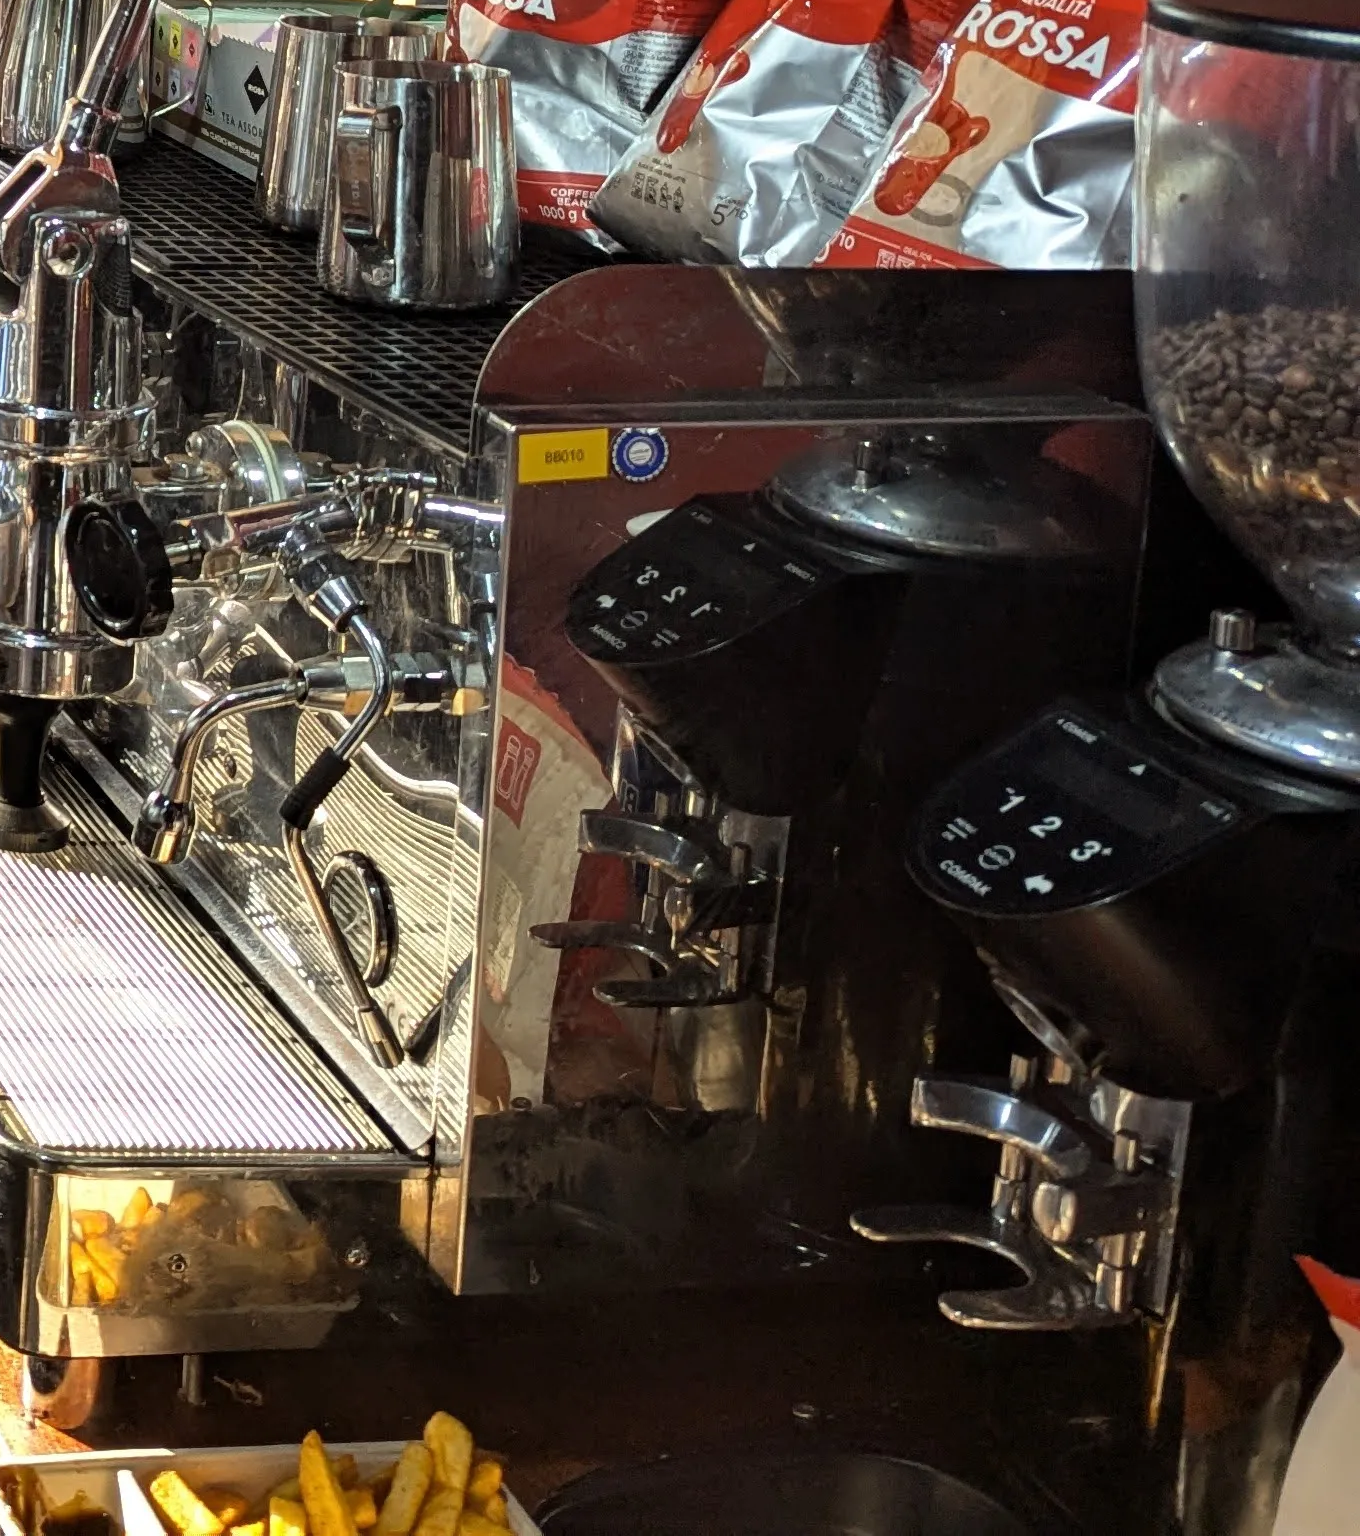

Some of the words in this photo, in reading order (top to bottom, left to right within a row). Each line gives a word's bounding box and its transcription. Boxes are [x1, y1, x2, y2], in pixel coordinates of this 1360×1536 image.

[953, 2, 1111, 80] ROSSA
[221, 111, 236, 128] TEA
[538, 204, 565, 221] 1000
[1028, 815, 1063, 839] 2
